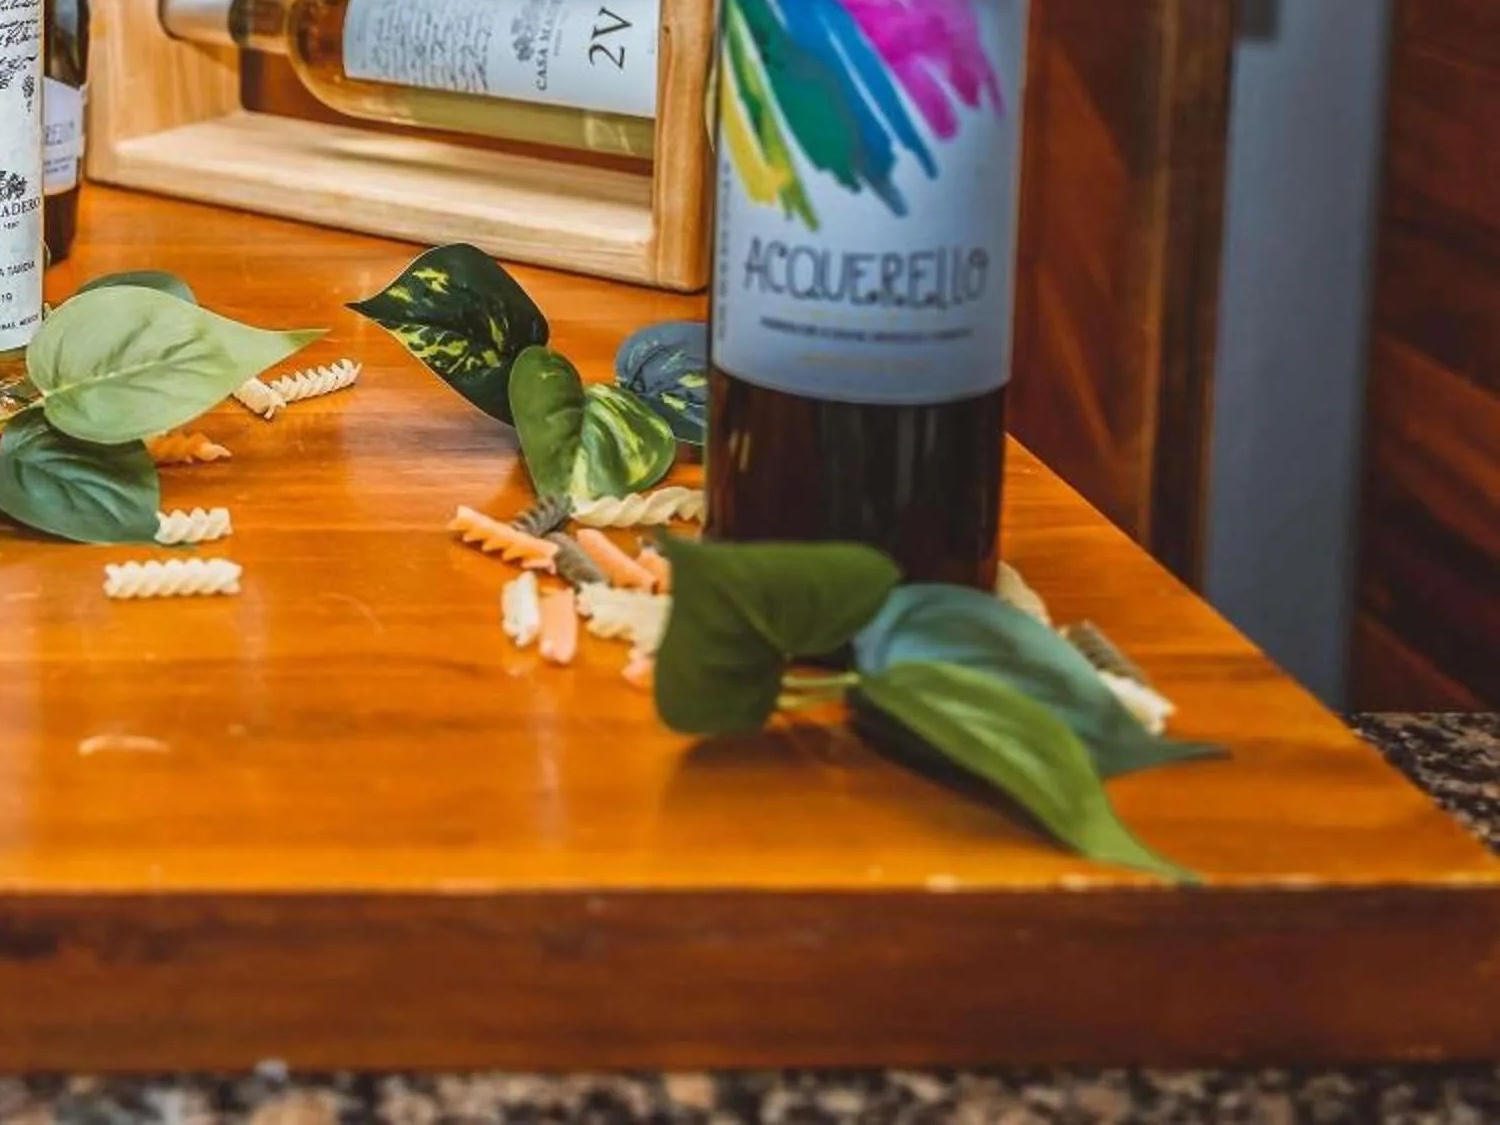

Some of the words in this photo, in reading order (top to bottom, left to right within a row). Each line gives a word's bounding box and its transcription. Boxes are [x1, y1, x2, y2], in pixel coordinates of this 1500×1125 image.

[536, 48, 549, 91] CASA
[587, 5, 634, 71] 2V
[743, 235, 991, 311] ACQUERELLO
